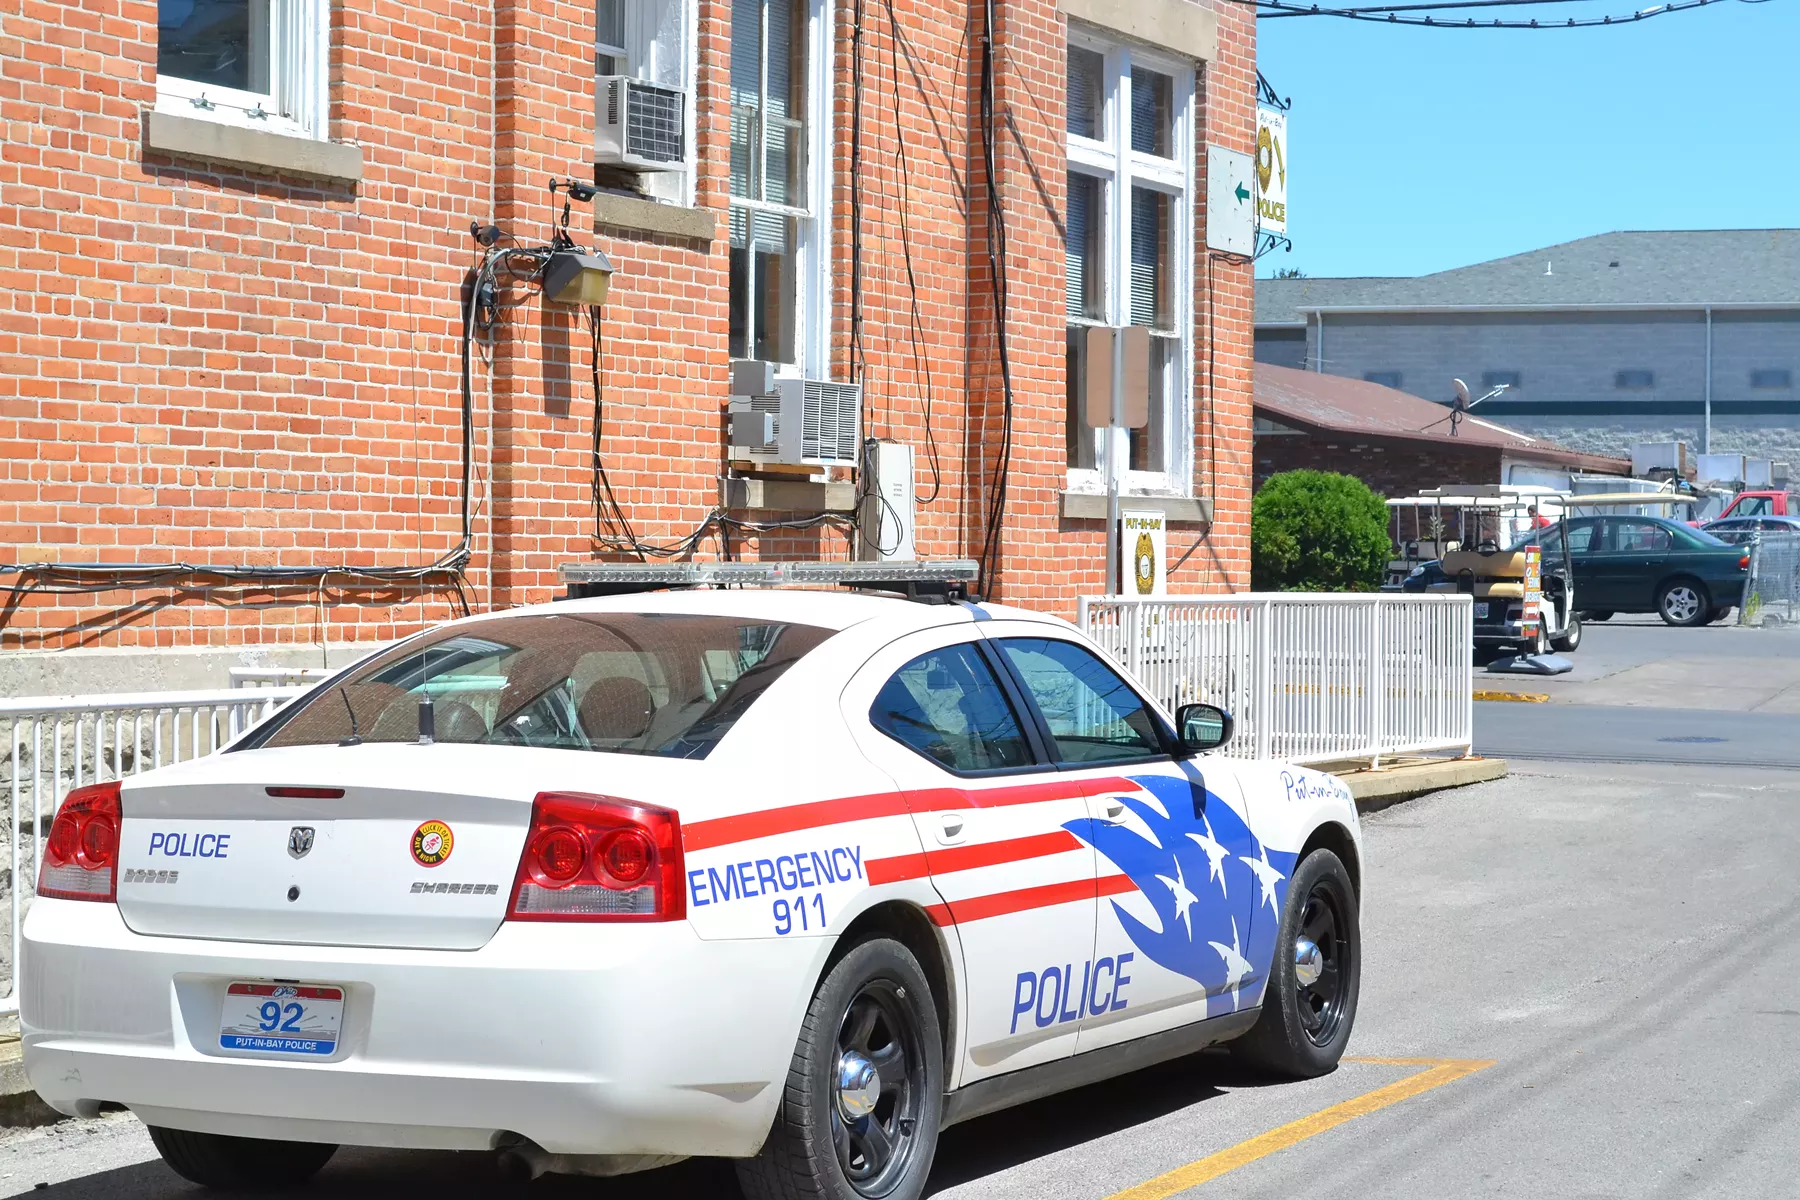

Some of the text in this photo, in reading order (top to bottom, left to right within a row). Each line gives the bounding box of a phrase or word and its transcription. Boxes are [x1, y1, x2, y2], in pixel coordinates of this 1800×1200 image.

[1256, 197, 1285, 222] POLICE
[1126, 517, 1162, 530] PUT-IN-BAY
[148, 832, 231, 858] POLICE
[414, 837, 422, 848] DAY
[419, 853, 437, 863] NIGHT
[422, 825, 436, 834] CLICK
[440, 838, 450, 856] TICKET
[687, 845, 863, 907] EMERGENCY
[772, 892, 827, 935] 911
[1009, 952, 1135, 1035] POLICE
[259, 1001, 304, 1033] 92
[235, 1037, 317, 1051] PUT-IN-BAY POLICE
